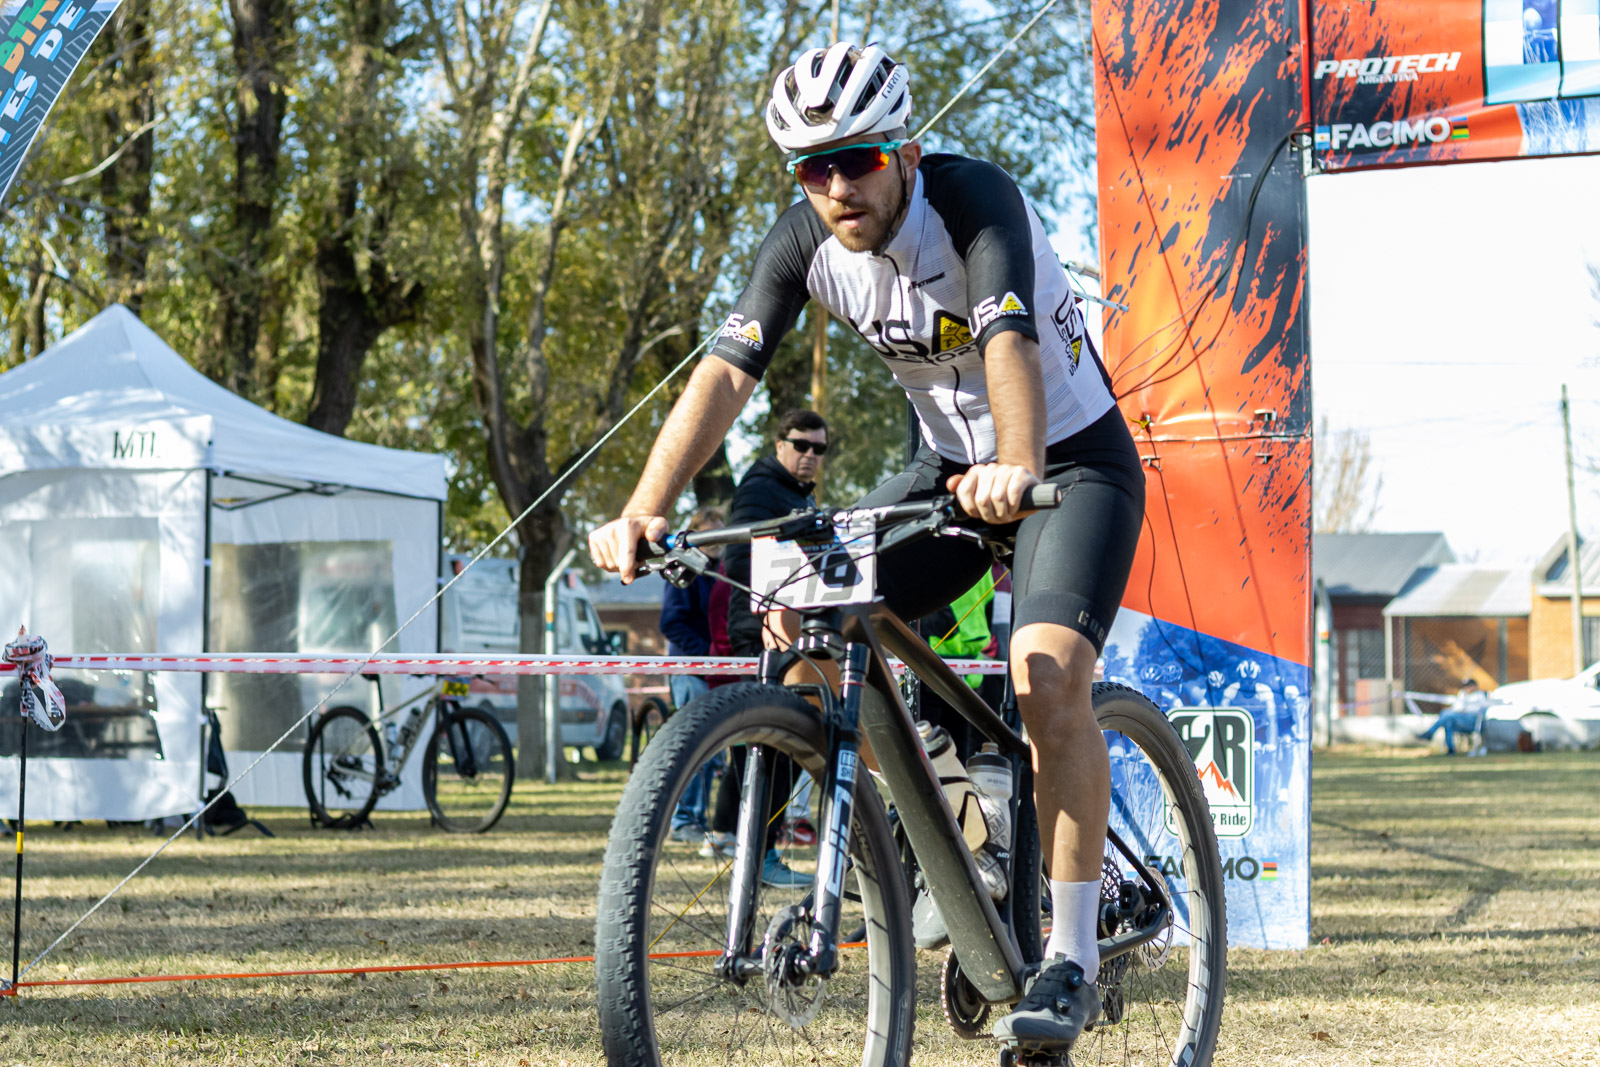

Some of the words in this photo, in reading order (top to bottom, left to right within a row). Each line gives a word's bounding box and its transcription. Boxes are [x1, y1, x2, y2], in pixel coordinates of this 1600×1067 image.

[30, 0, 86, 62] DE
[1314, 52, 1461, 79] PROTECH
[1356, 71, 1418, 84] ARGENTINA
[1331, 117, 1450, 149] FACIMO
[968, 291, 1026, 339] USA
[1221, 812, 1247, 826] Ride
[1143, 855, 1259, 882] FAMO
